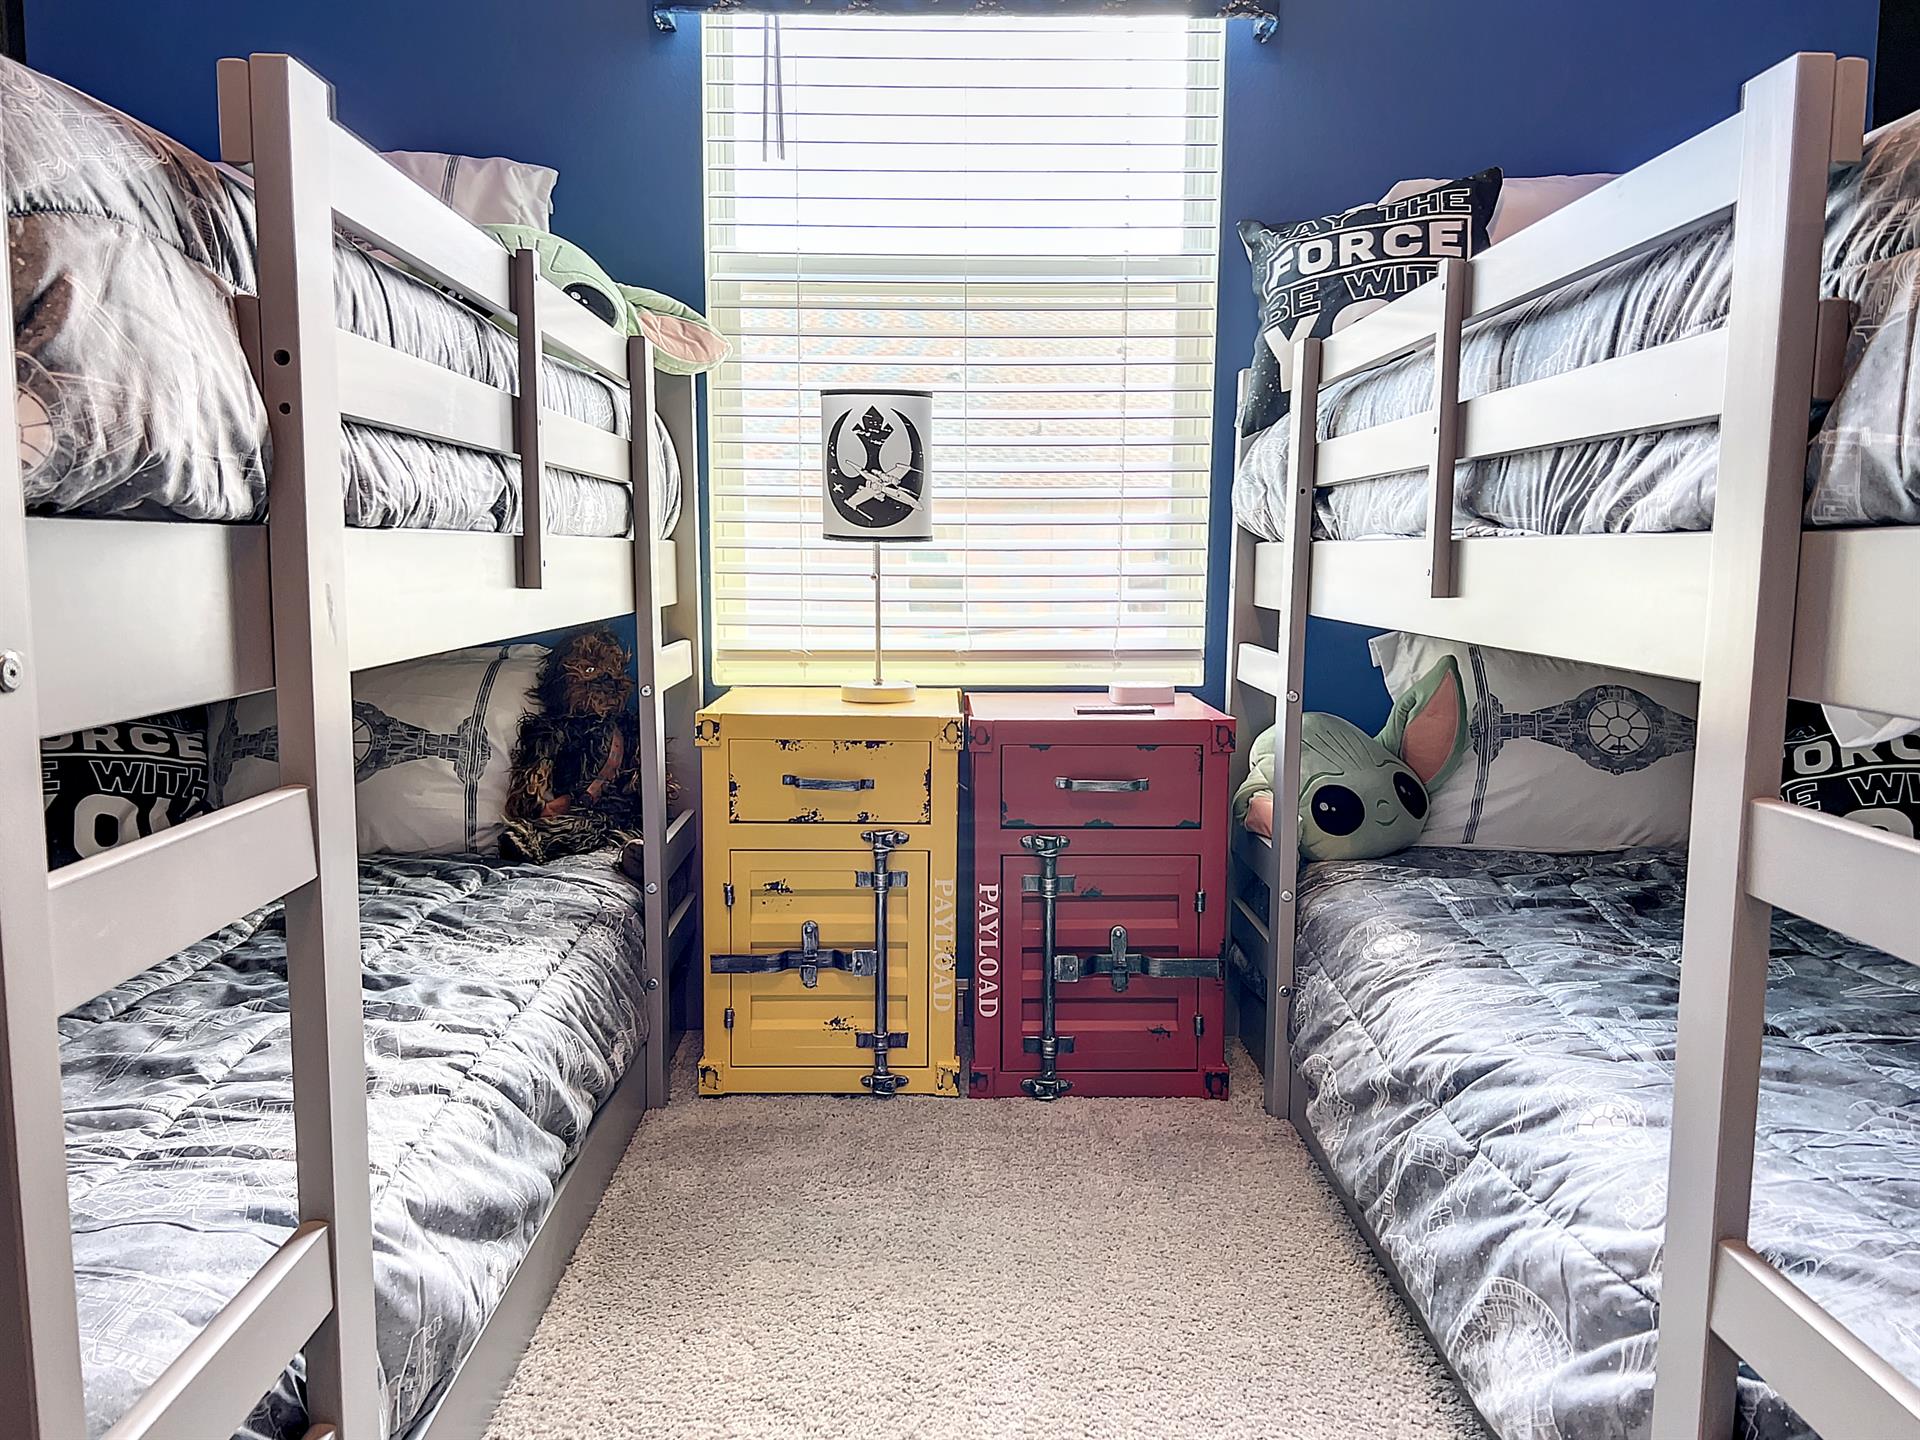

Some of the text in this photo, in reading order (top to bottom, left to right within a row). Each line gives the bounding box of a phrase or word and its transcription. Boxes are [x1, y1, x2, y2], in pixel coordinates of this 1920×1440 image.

[1377, 187, 1472, 222] THE
[1267, 220, 1465, 292] FORCE
[1263, 264, 1439, 332] BE WIT
[88, 759, 208, 799] WITH
[1847, 771, 1920, 806] WI
[933, 878, 955, 1013] PAYLOAD
[978, 883, 1000, 1018] PAYLOAD
